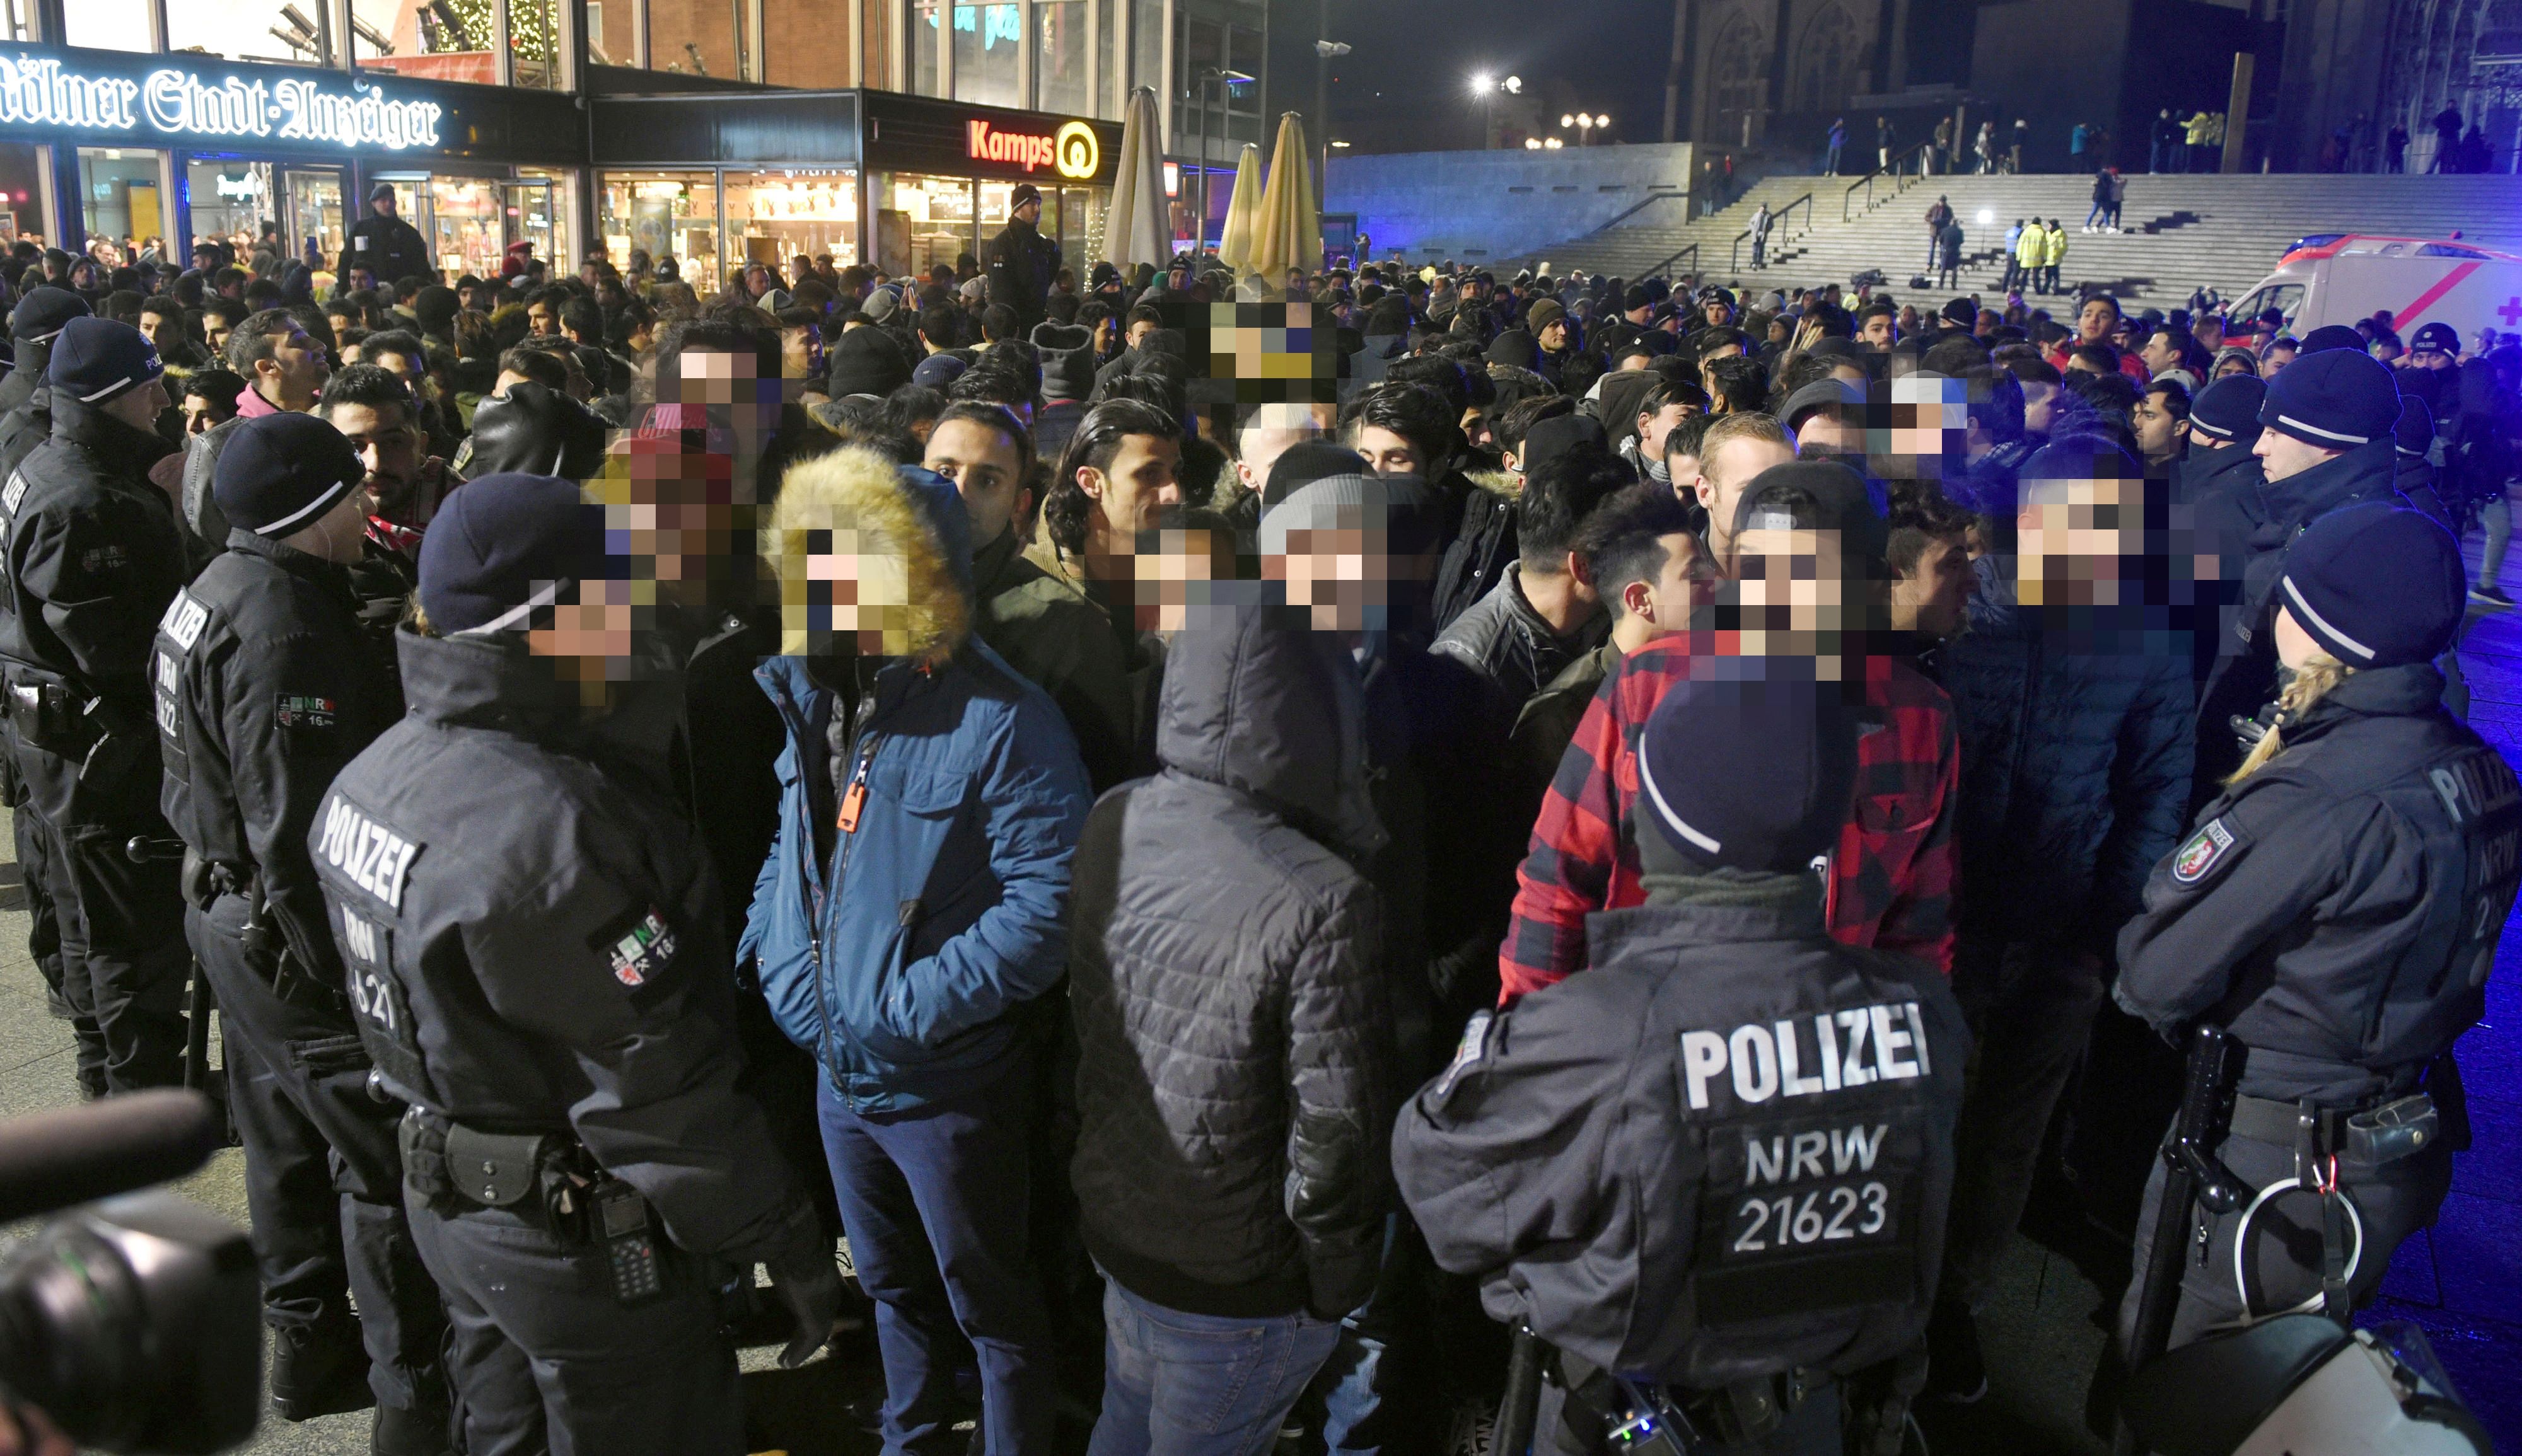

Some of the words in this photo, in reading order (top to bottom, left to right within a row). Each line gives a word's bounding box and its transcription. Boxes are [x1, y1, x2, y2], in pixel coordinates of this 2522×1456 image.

[142, 69, 442, 149] Stadt-Anzeiger
[968, 118, 1054, 172] Kamps
[145, 353, 163, 370] POLI
[318, 795, 417, 908] POLIZEI
[1681, 1002, 1931, 1109] POLIZEI
[1745, 1124, 1888, 1186] NRW
[1734, 1182, 1888, 1252] 21623
